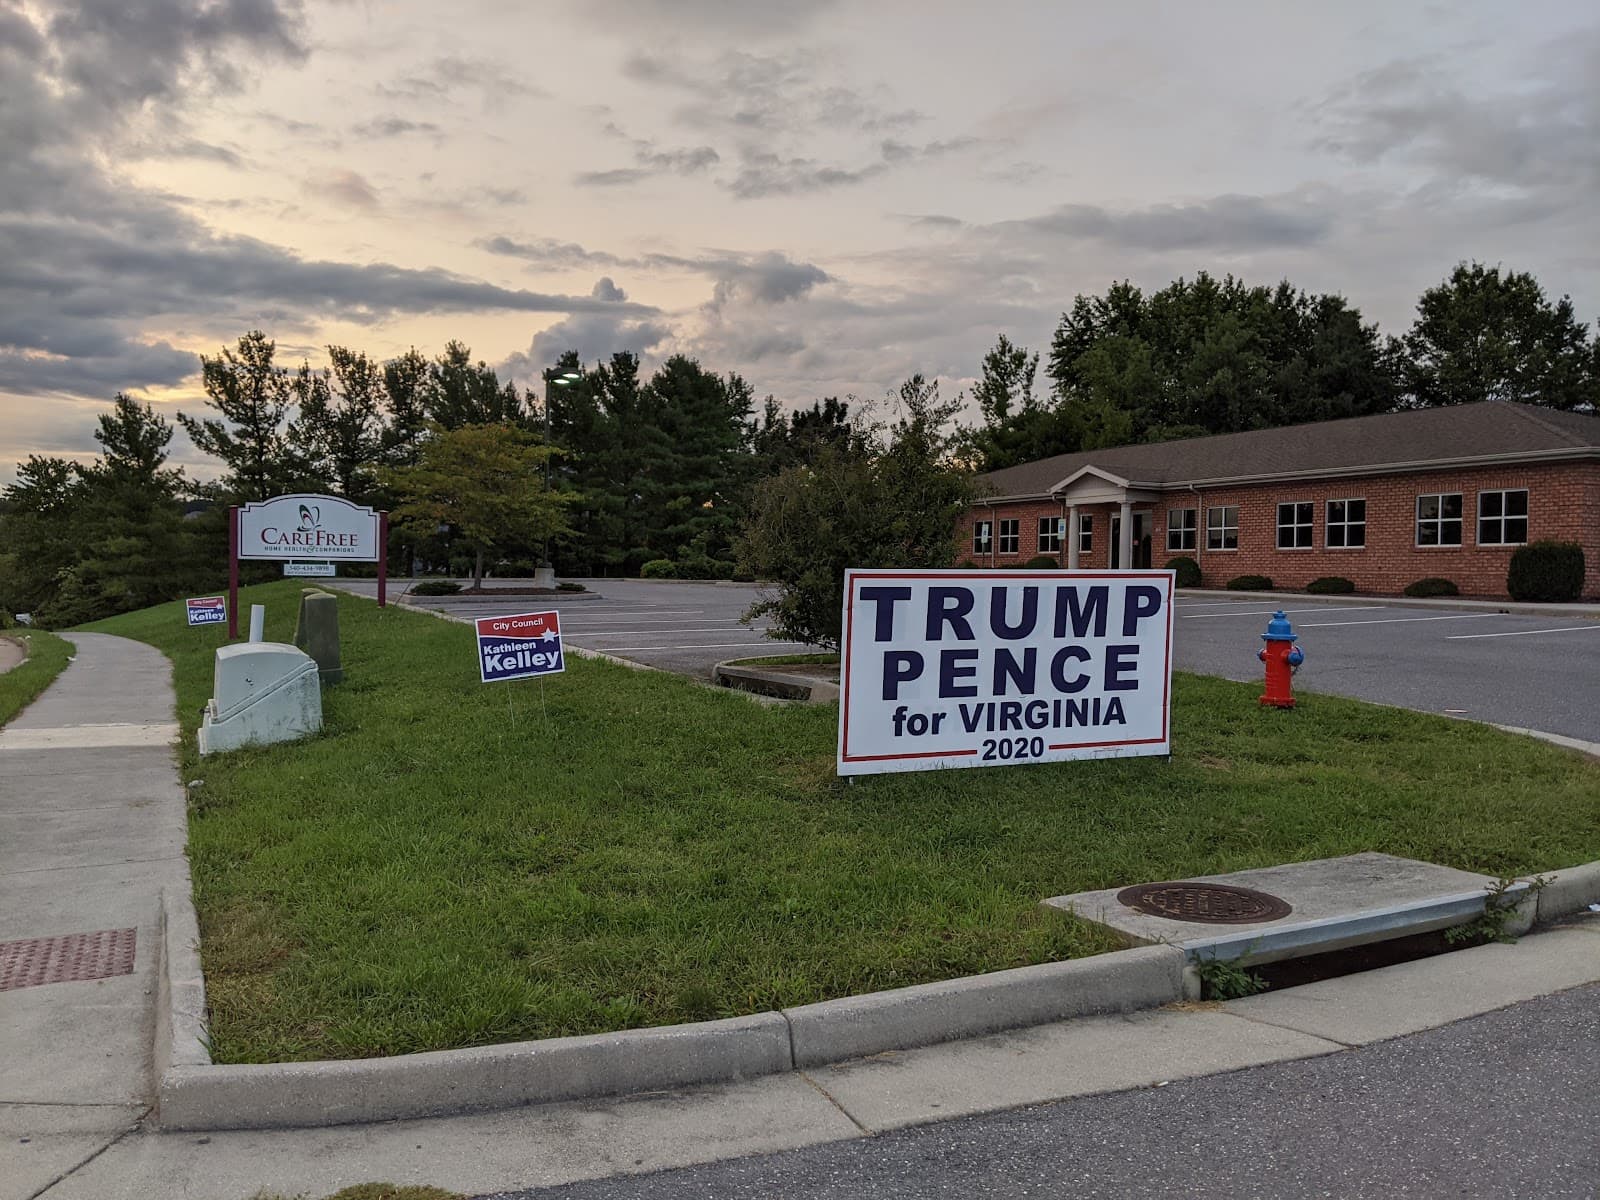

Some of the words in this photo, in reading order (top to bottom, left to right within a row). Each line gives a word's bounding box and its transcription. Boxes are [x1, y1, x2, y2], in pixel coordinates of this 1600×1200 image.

[190, 612, 225, 622] Kelley
[493, 622, 509, 631] City
[512, 618, 543, 628] Council
[859, 585, 1162, 642] TRUMP
[483, 642, 536, 655] Kathleen
[484, 650, 559, 673] Kelley
[882, 644, 1140, 701] PENCE
[892, 705, 948, 737] for
[958, 696, 1127, 733] VIRGINIA
[982, 736, 1045, 761] 2020
